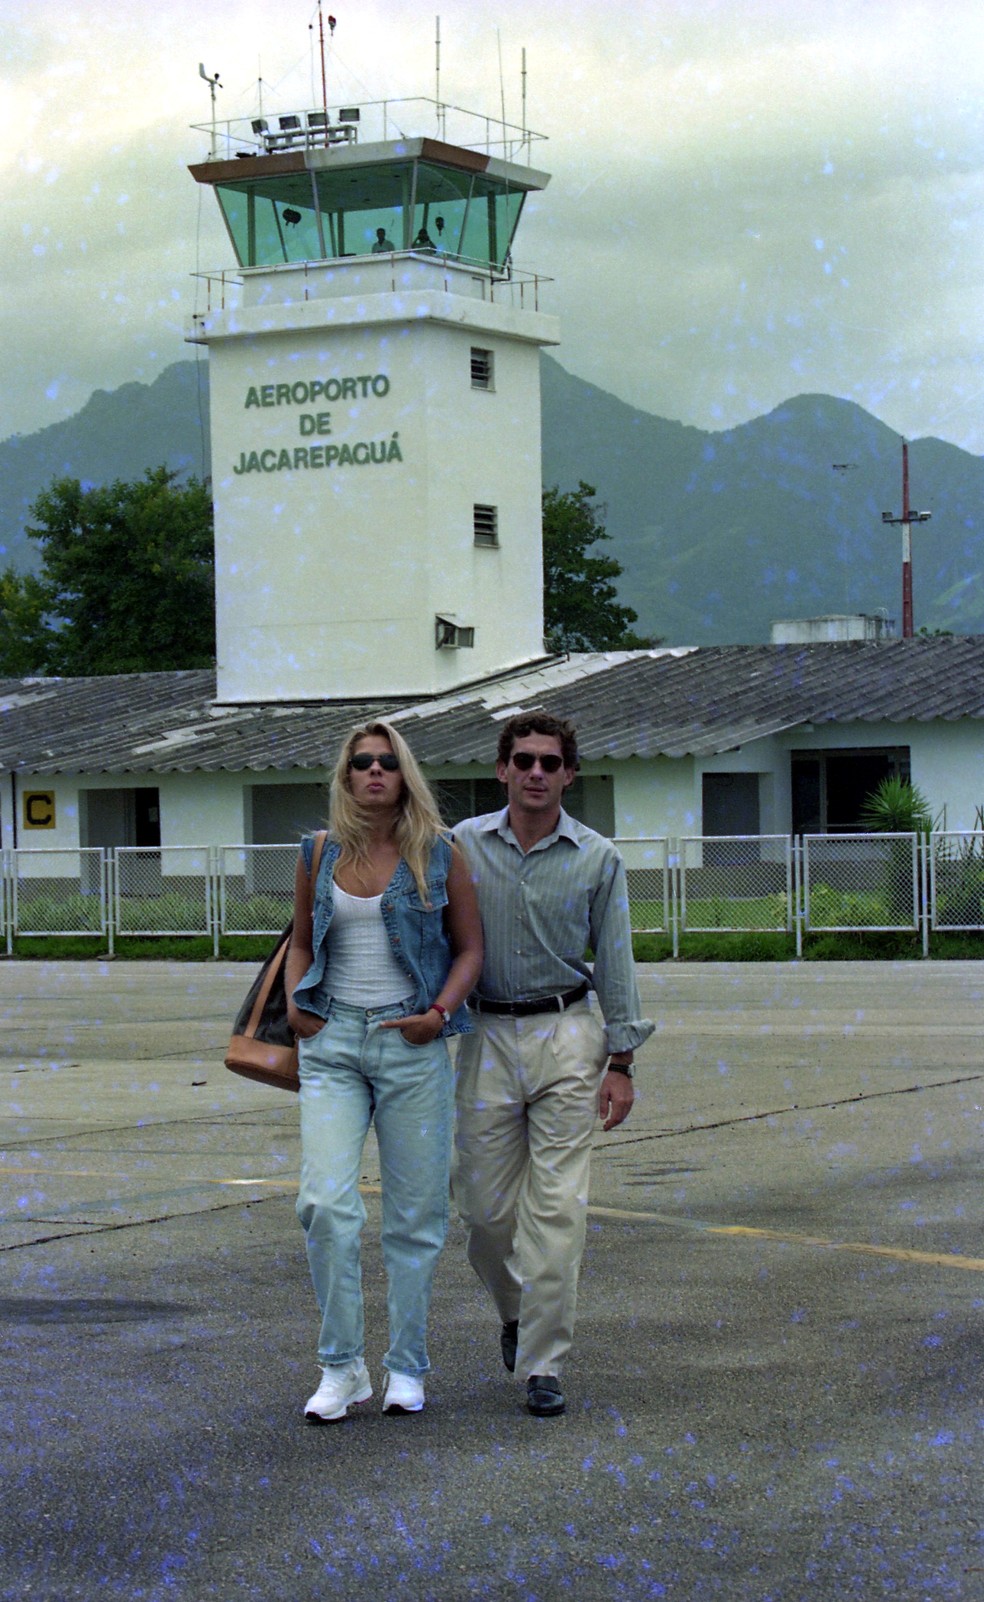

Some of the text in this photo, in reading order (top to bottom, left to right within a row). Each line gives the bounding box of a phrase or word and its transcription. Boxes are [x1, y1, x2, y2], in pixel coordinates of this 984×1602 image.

[244, 374, 390, 409] AEROPORTO
[299, 412, 332, 436] DE
[233, 431, 403, 475] JACAREPAGUÁ
[26, 794, 52, 825] C
